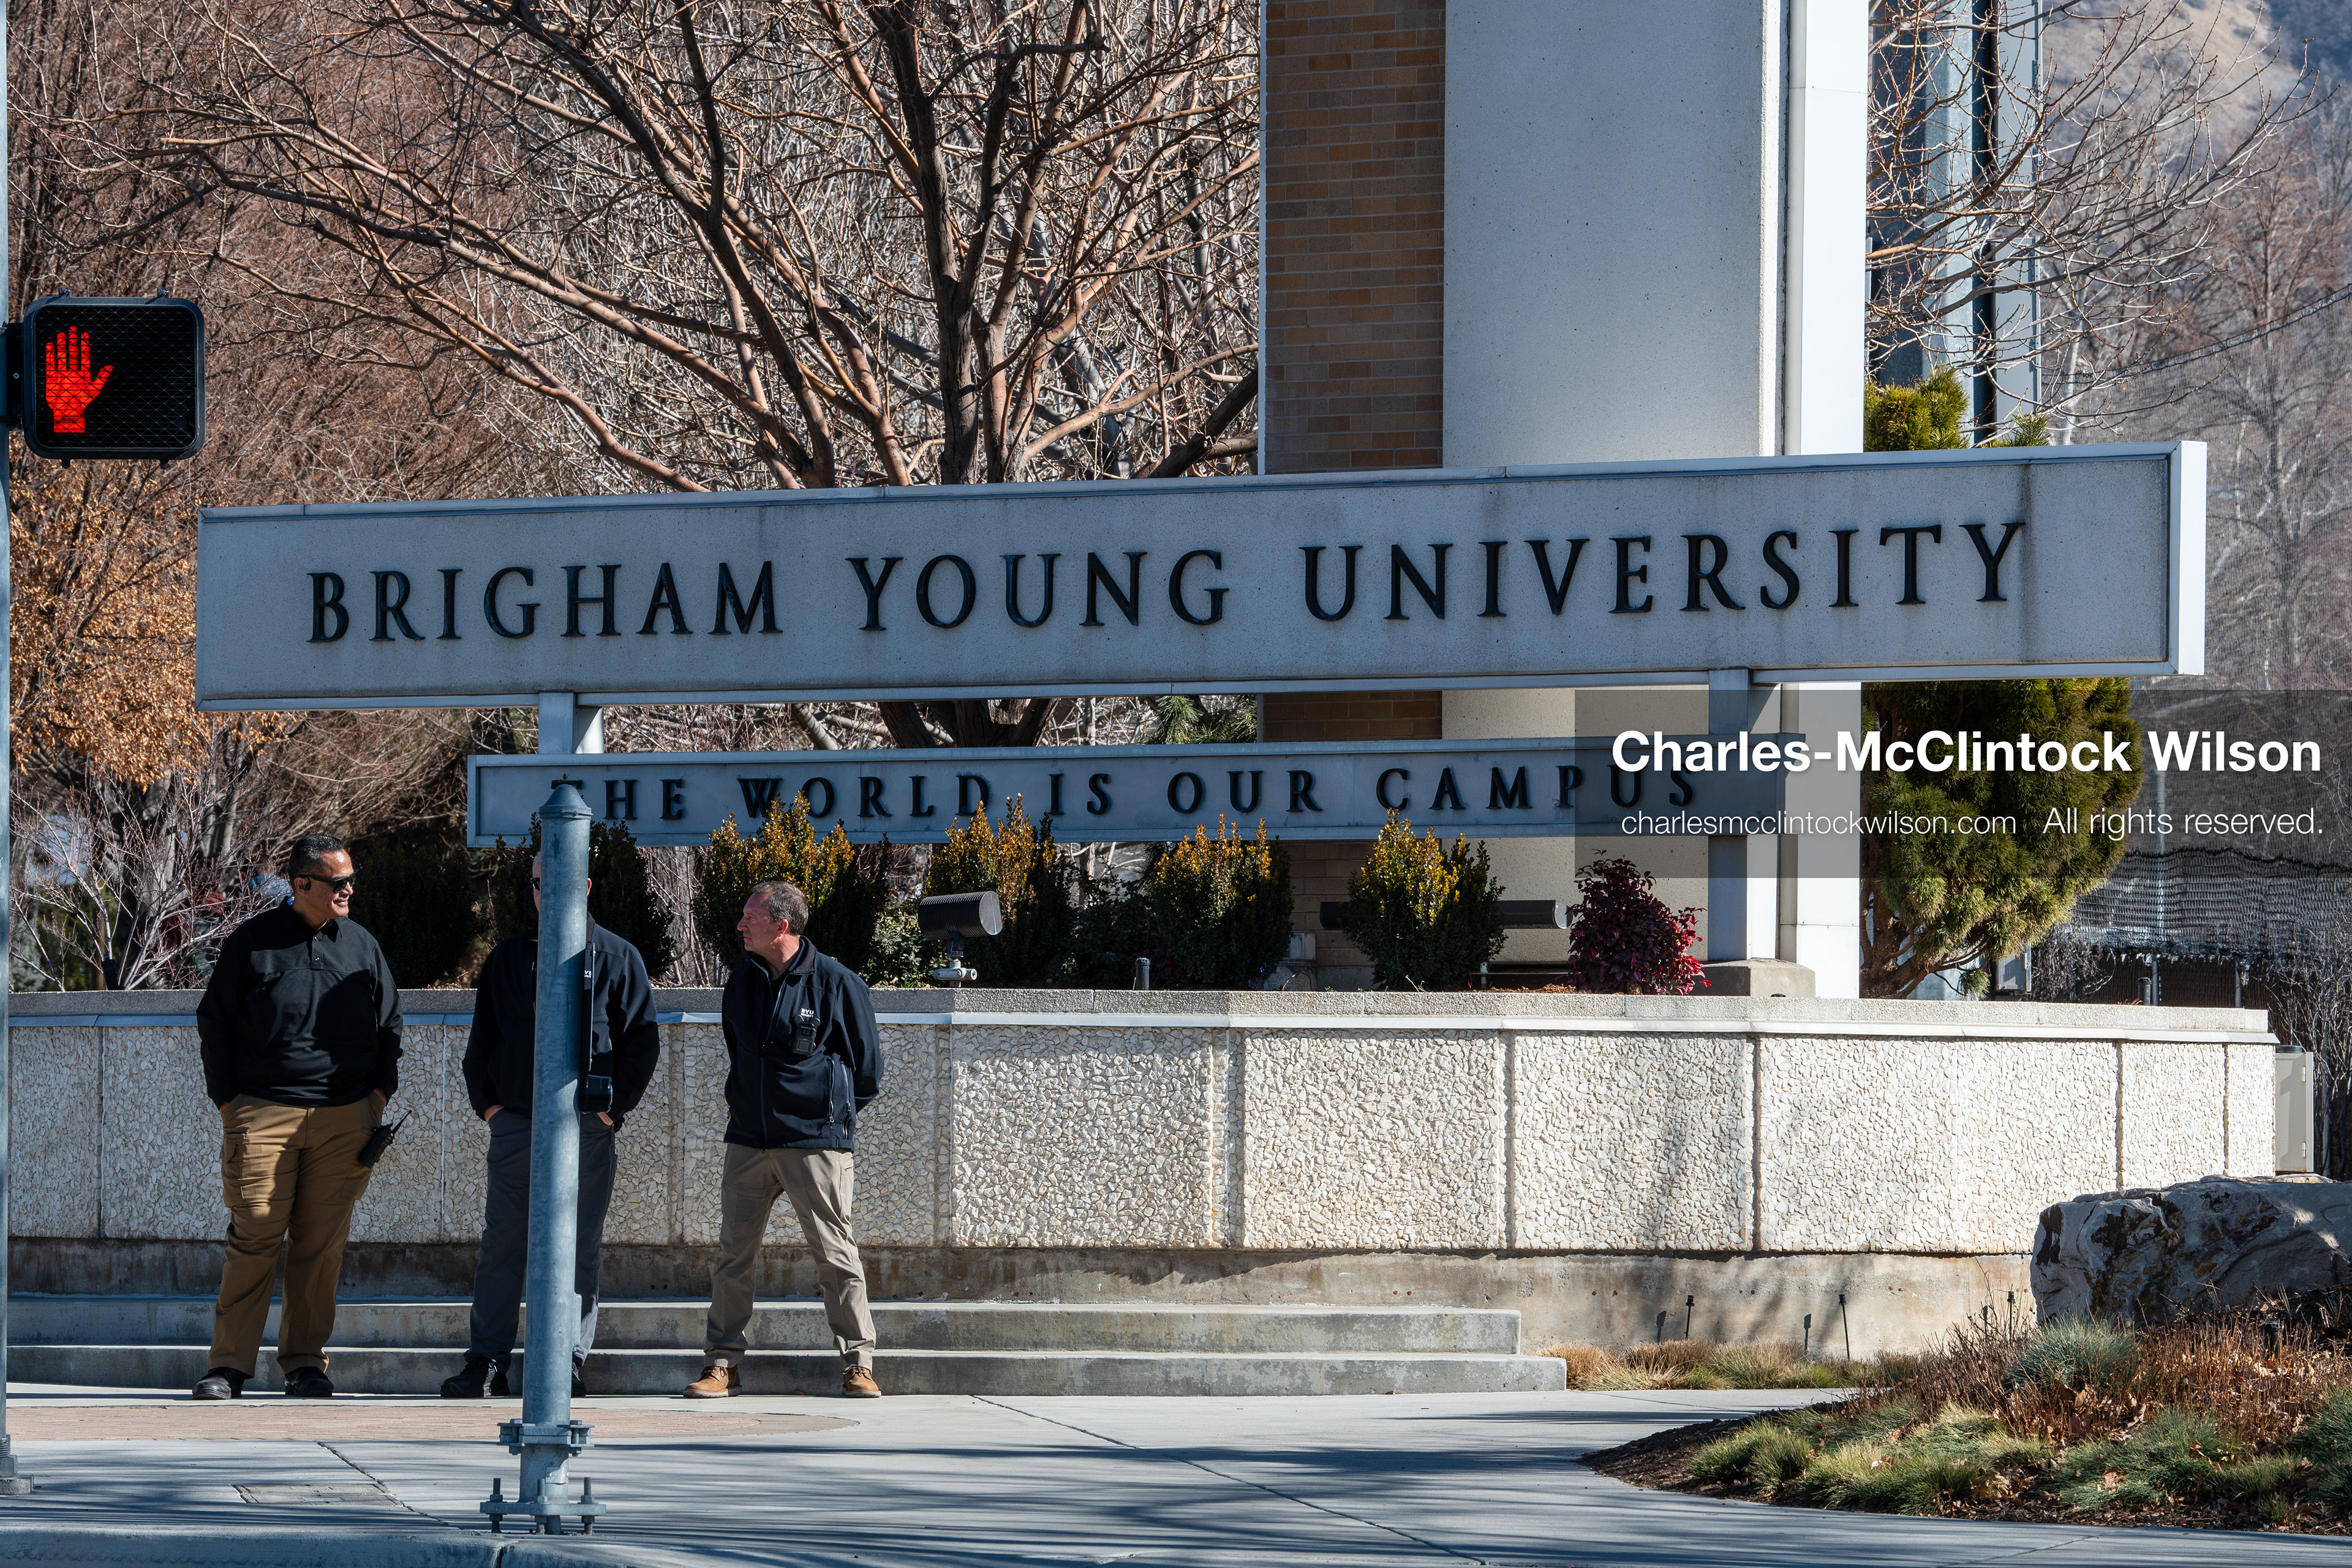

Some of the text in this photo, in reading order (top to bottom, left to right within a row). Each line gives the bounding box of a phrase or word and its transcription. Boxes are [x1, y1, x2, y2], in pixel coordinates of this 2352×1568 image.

[306, 522, 2027, 643] BRIGHAM YOUNG UNIVERSITY
[736, 774, 990, 819] WORLD
[1047, 772, 1110, 815] IS
[1167, 769, 1324, 813] OUR
[1376, 763, 1694, 810] CAMPUS
